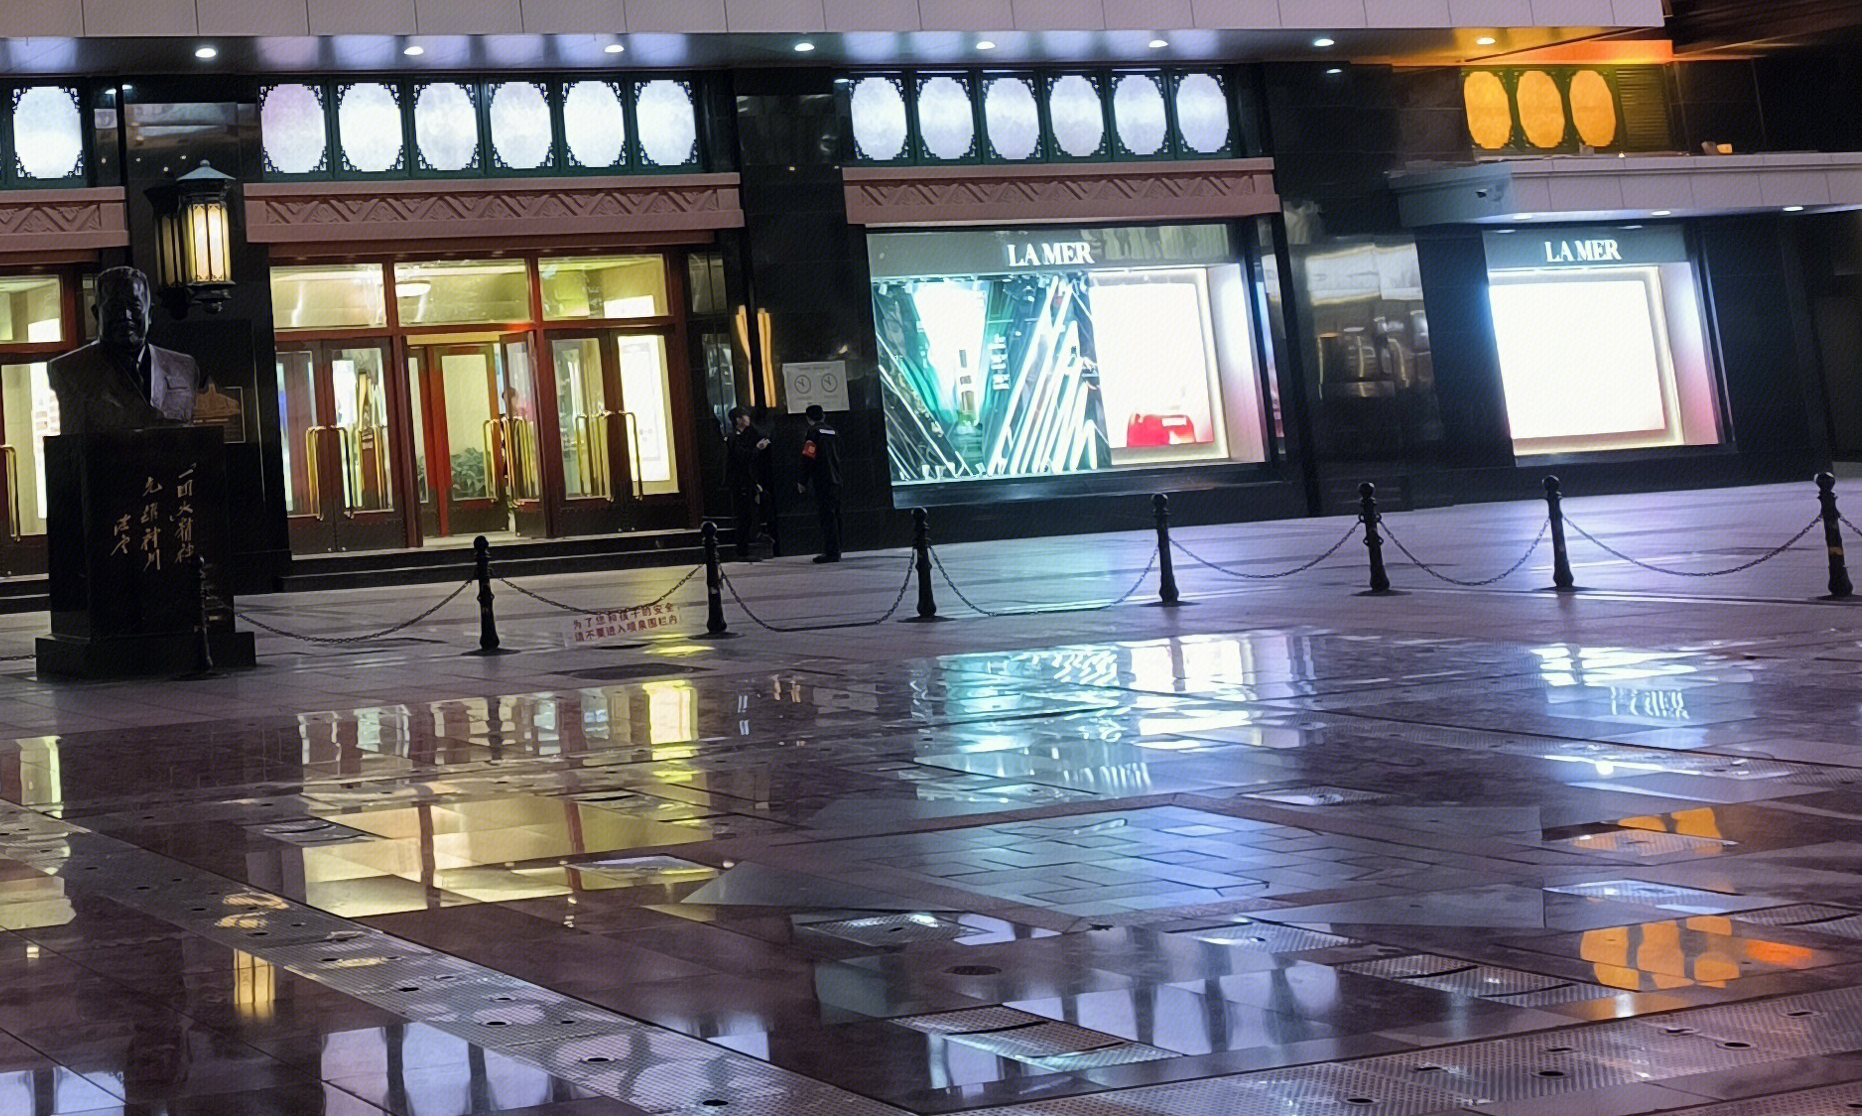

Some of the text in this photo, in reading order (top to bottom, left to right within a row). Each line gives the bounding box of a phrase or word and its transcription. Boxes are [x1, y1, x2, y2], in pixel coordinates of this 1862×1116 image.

[1007, 241, 1095, 267] LA MER
[1544, 239, 1623, 262] LA MER
